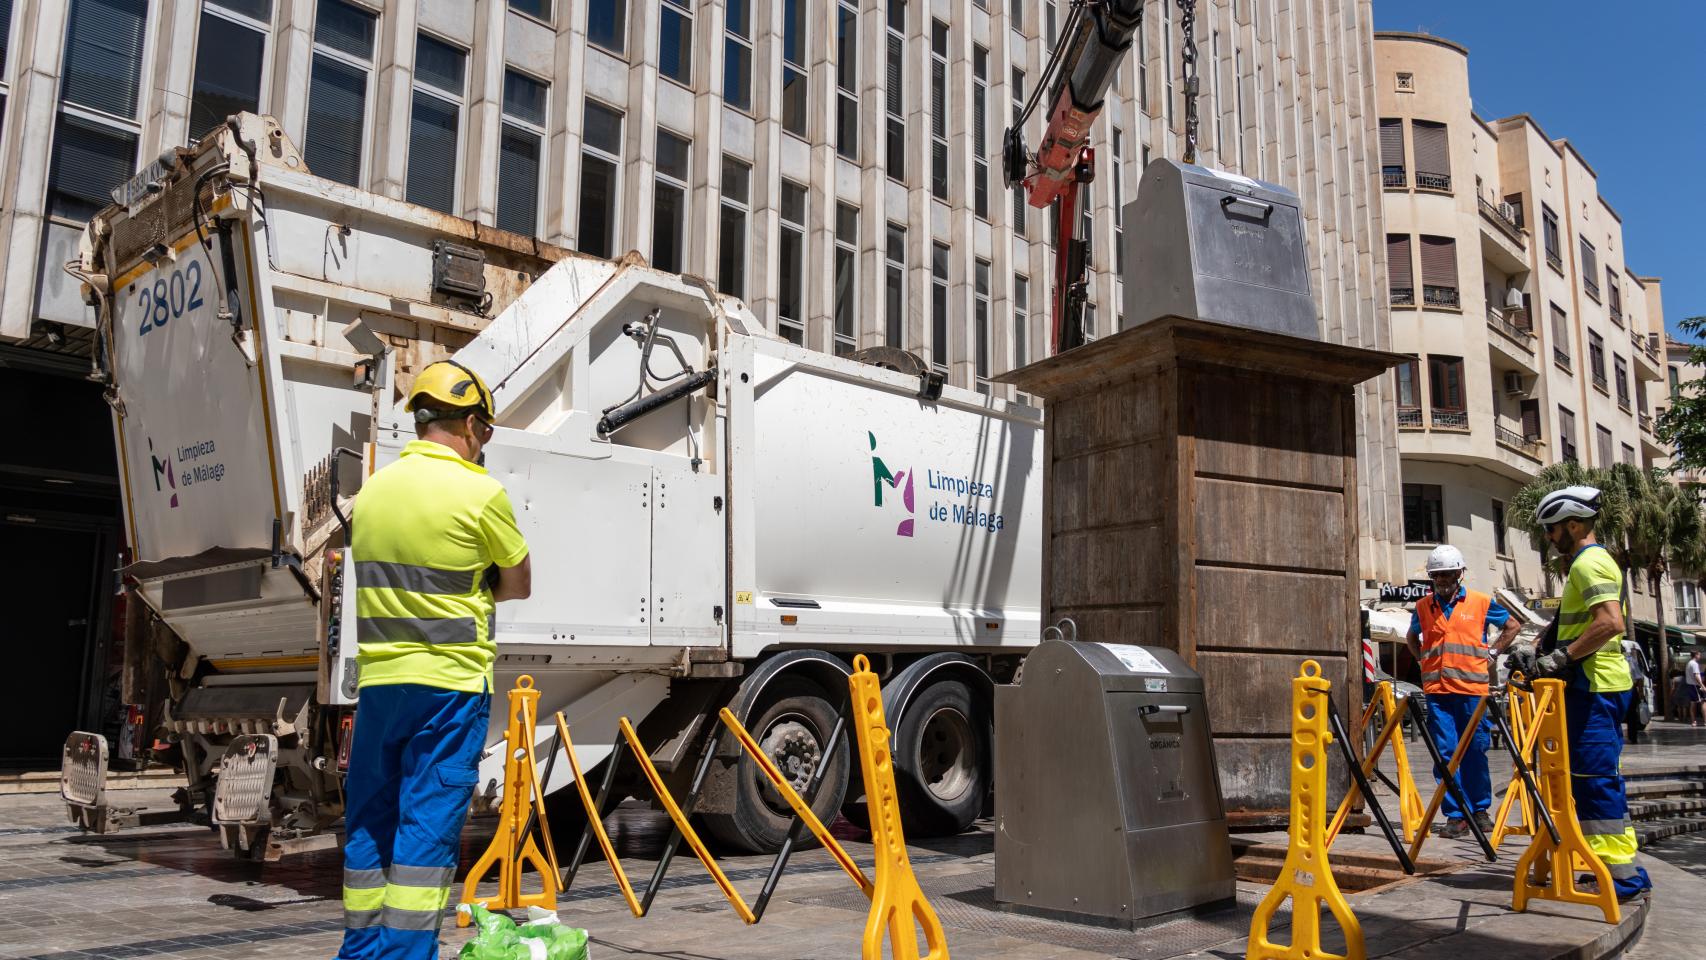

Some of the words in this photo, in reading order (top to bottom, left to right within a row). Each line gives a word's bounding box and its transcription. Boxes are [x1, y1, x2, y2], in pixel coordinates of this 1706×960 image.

[139, 260, 204, 336] 2802
[177, 438, 215, 463] Limpieza
[181, 470, 192, 487] de
[193, 462, 226, 484] Málaga
[928, 468, 993, 499] Limpieza
[929, 501, 948, 522] de
[953, 504, 1005, 533] Málaga
